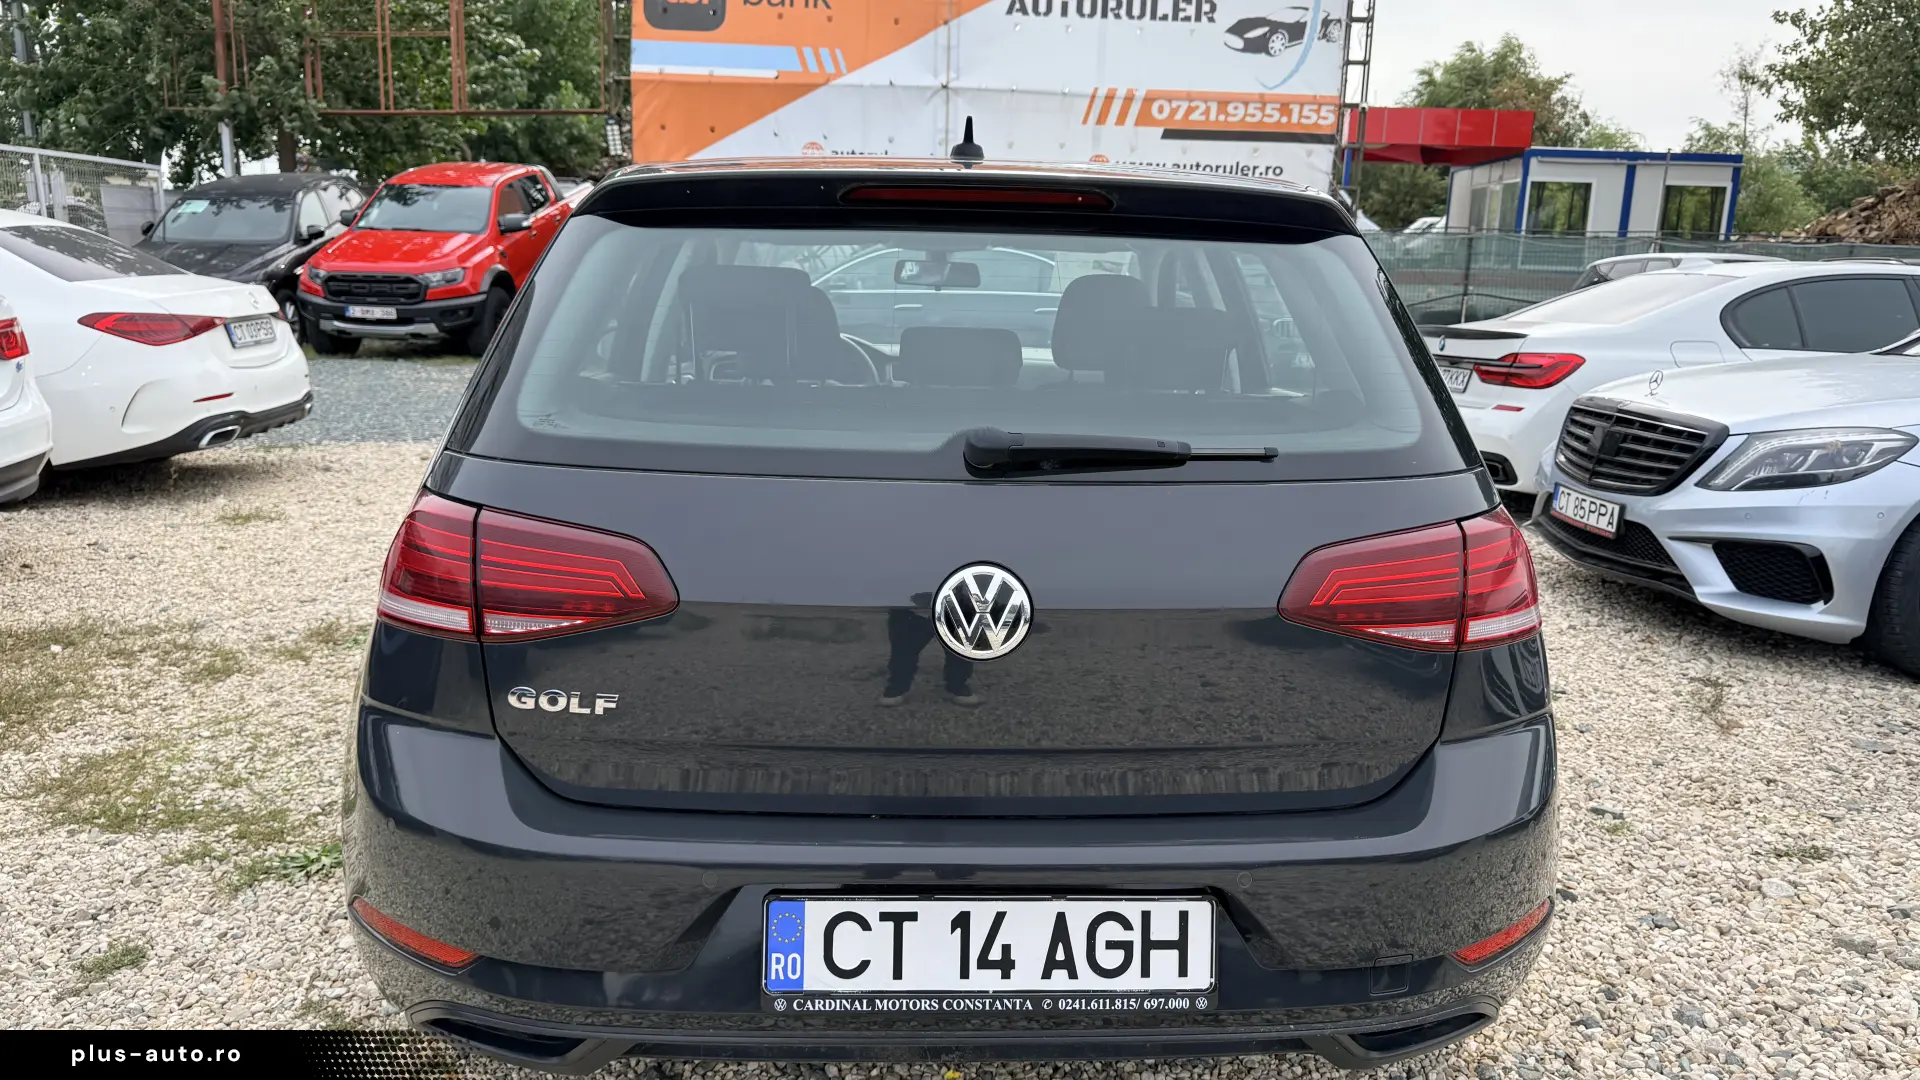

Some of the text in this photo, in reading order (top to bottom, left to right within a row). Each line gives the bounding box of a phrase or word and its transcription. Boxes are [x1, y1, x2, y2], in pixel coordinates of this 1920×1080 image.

[1005, 0, 1218, 23] AUTORULER
[1151, 98, 1336, 126] 0721.955.155
[1115, 160, 1284, 177] autoruler.ro
[328, 281, 421, 294] FORD
[233, 323, 247, 341] CT
[1557, 489, 1572, 514] CT
[507, 685, 620, 715] GOLF
[823, 909, 1190, 981] CT 14 AGH
[770, 951, 802, 981] RO
[792, 998, 872, 1011] CARDINAL
[874, 998, 939, 1011] MOTORS
[942, 998, 1033, 1011] CONSTANTA
[1143, 998, 1190, 1010] 697.000
